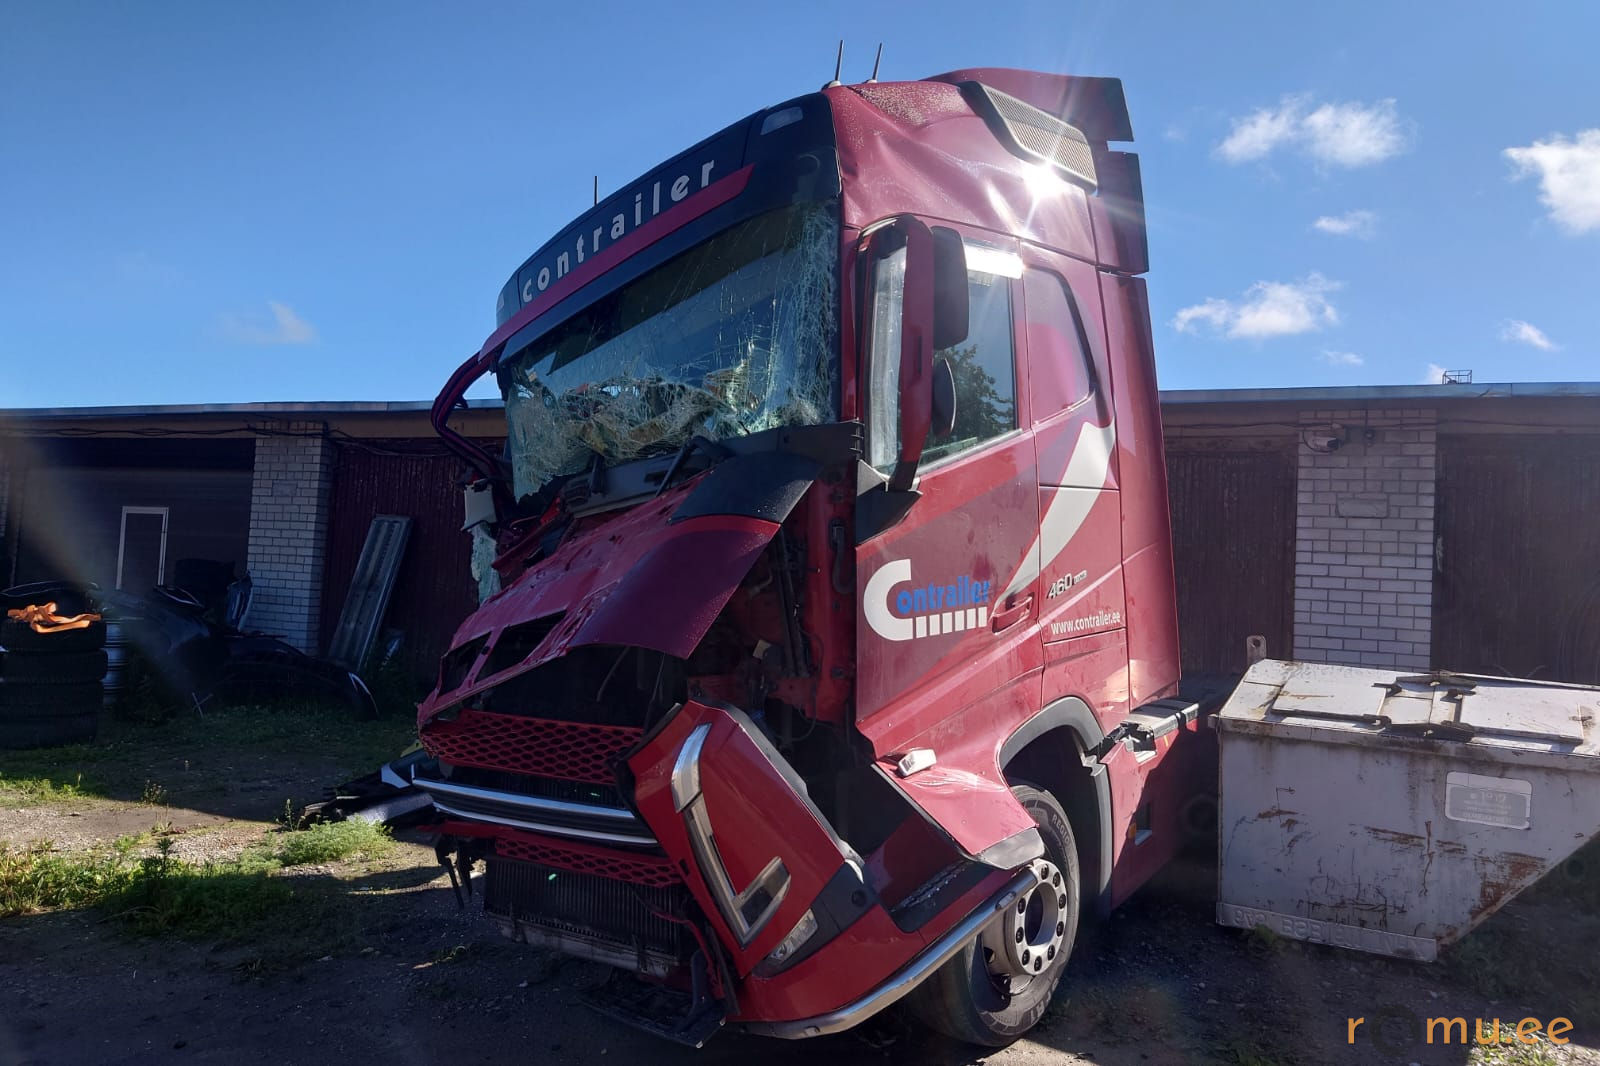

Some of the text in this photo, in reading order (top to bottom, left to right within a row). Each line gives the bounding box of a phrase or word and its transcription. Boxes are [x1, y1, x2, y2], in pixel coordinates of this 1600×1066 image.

[521, 160, 715, 303] contrailer
[864, 558, 990, 641] Contrailer
[1047, 573, 1073, 600] 460
[1050, 611, 1121, 635] www.contrailer.ee
